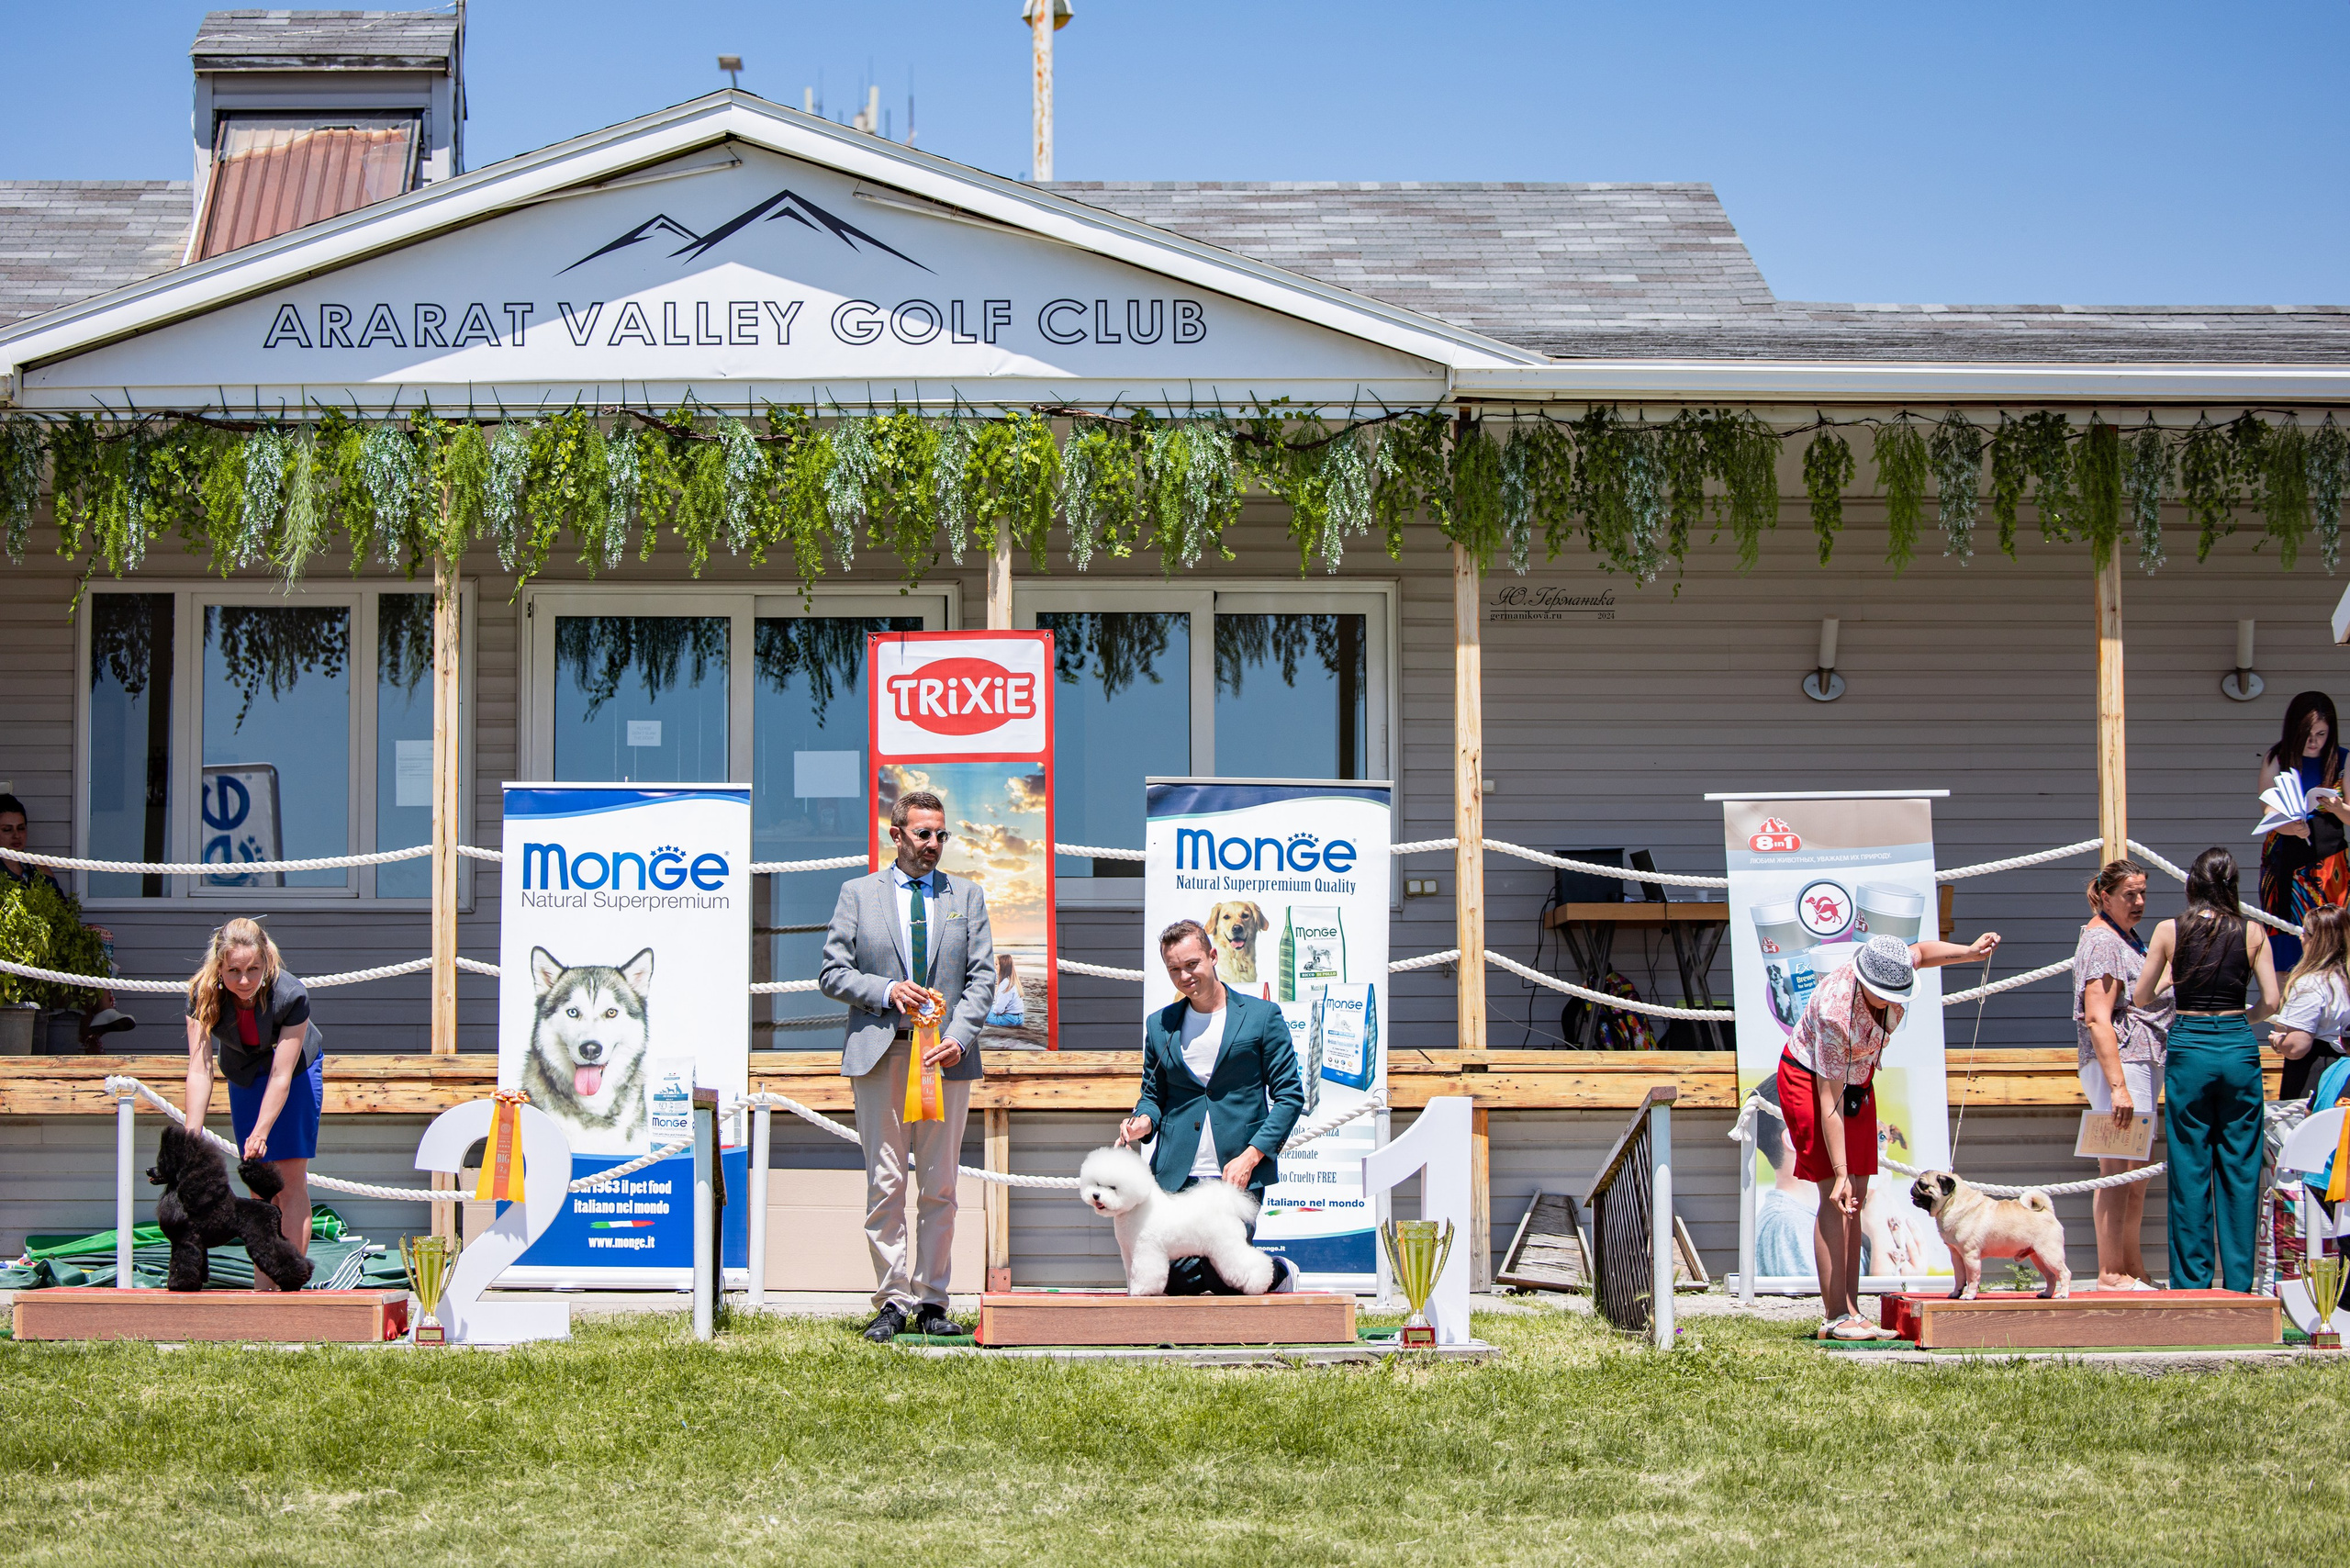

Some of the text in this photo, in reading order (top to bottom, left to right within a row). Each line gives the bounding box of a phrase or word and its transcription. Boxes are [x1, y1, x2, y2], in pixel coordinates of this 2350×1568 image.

[263, 298, 1208, 349] ARARAT VALLEY GOLF CLUB
[1755, 835, 1794, 851] 8in1
[1817, 855, 1850, 863] УВАЖАЕМ
[1861, 852, 1892, 860] ПРИРОДУ.
[1176, 875, 1357, 896] Natural Superpremium Quality
[521, 891, 731, 912] Natural Superpremium
[922, 1075, 934, 1085] BIG
[497, 1153, 510, 1164] BIG
[1289, 1170, 1315, 1184] Cruelty
[1316, 1170, 1337, 1183] FREE
[621, 1179, 630, 1194] il
[630, 1181, 648, 1196] pet
[648, 1180, 672, 1194] food
[574, 1199, 670, 1215] italiano nel mondo
[1267, 1197, 1306, 1206] italiano
[1309, 1198, 1326, 1207] nel
[1328, 1198, 1365, 1208] mondo
[405, 1098, 572, 1345] 2
[1361, 1096, 1471, 1344] 1
[588, 1235, 655, 1250] www.monge.it
